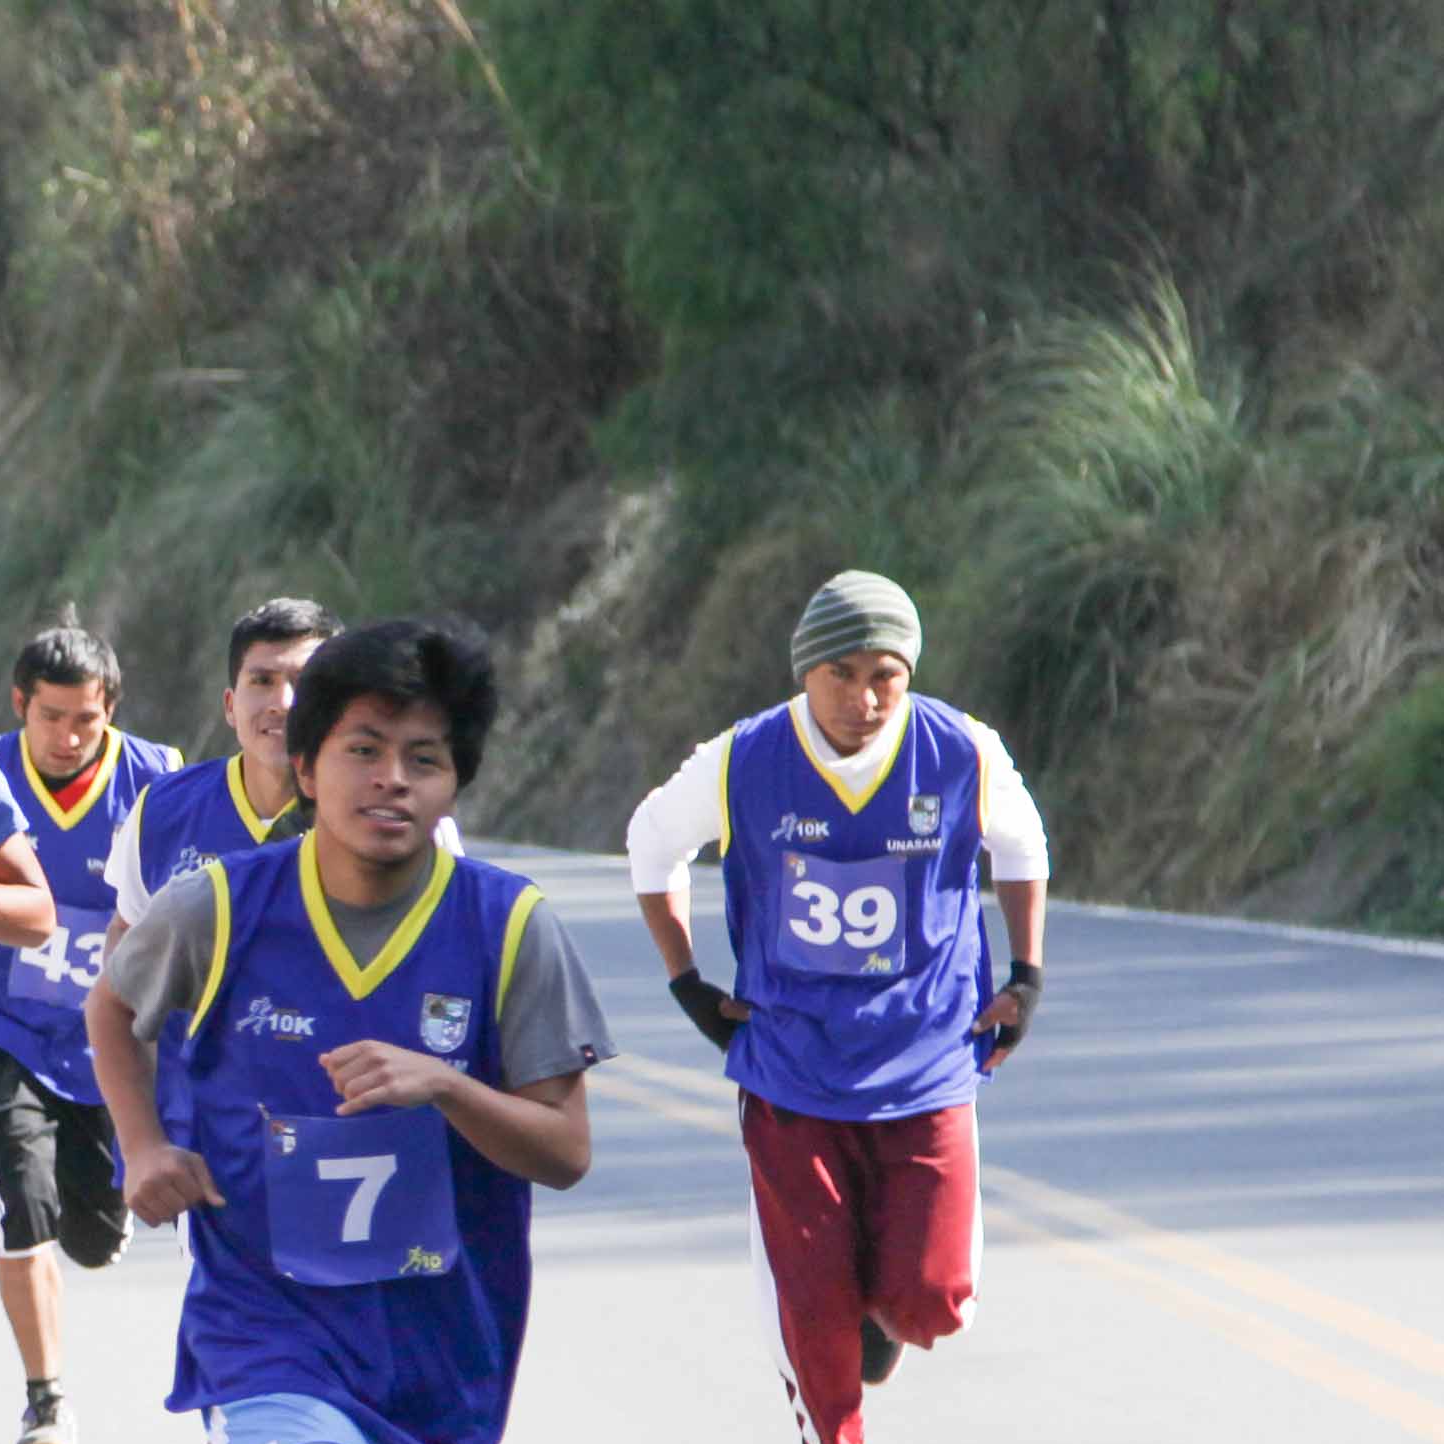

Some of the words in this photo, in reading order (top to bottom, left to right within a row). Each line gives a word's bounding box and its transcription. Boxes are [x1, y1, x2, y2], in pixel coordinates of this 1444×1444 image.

[797, 821, 830, 837] 10K
[887, 838, 941, 851] UNASAM
[789, 881, 897, 948] 39
[19, 926, 108, 988] 43
[268, 1014, 316, 1036] 10K
[317, 1154, 397, 1242] 7
